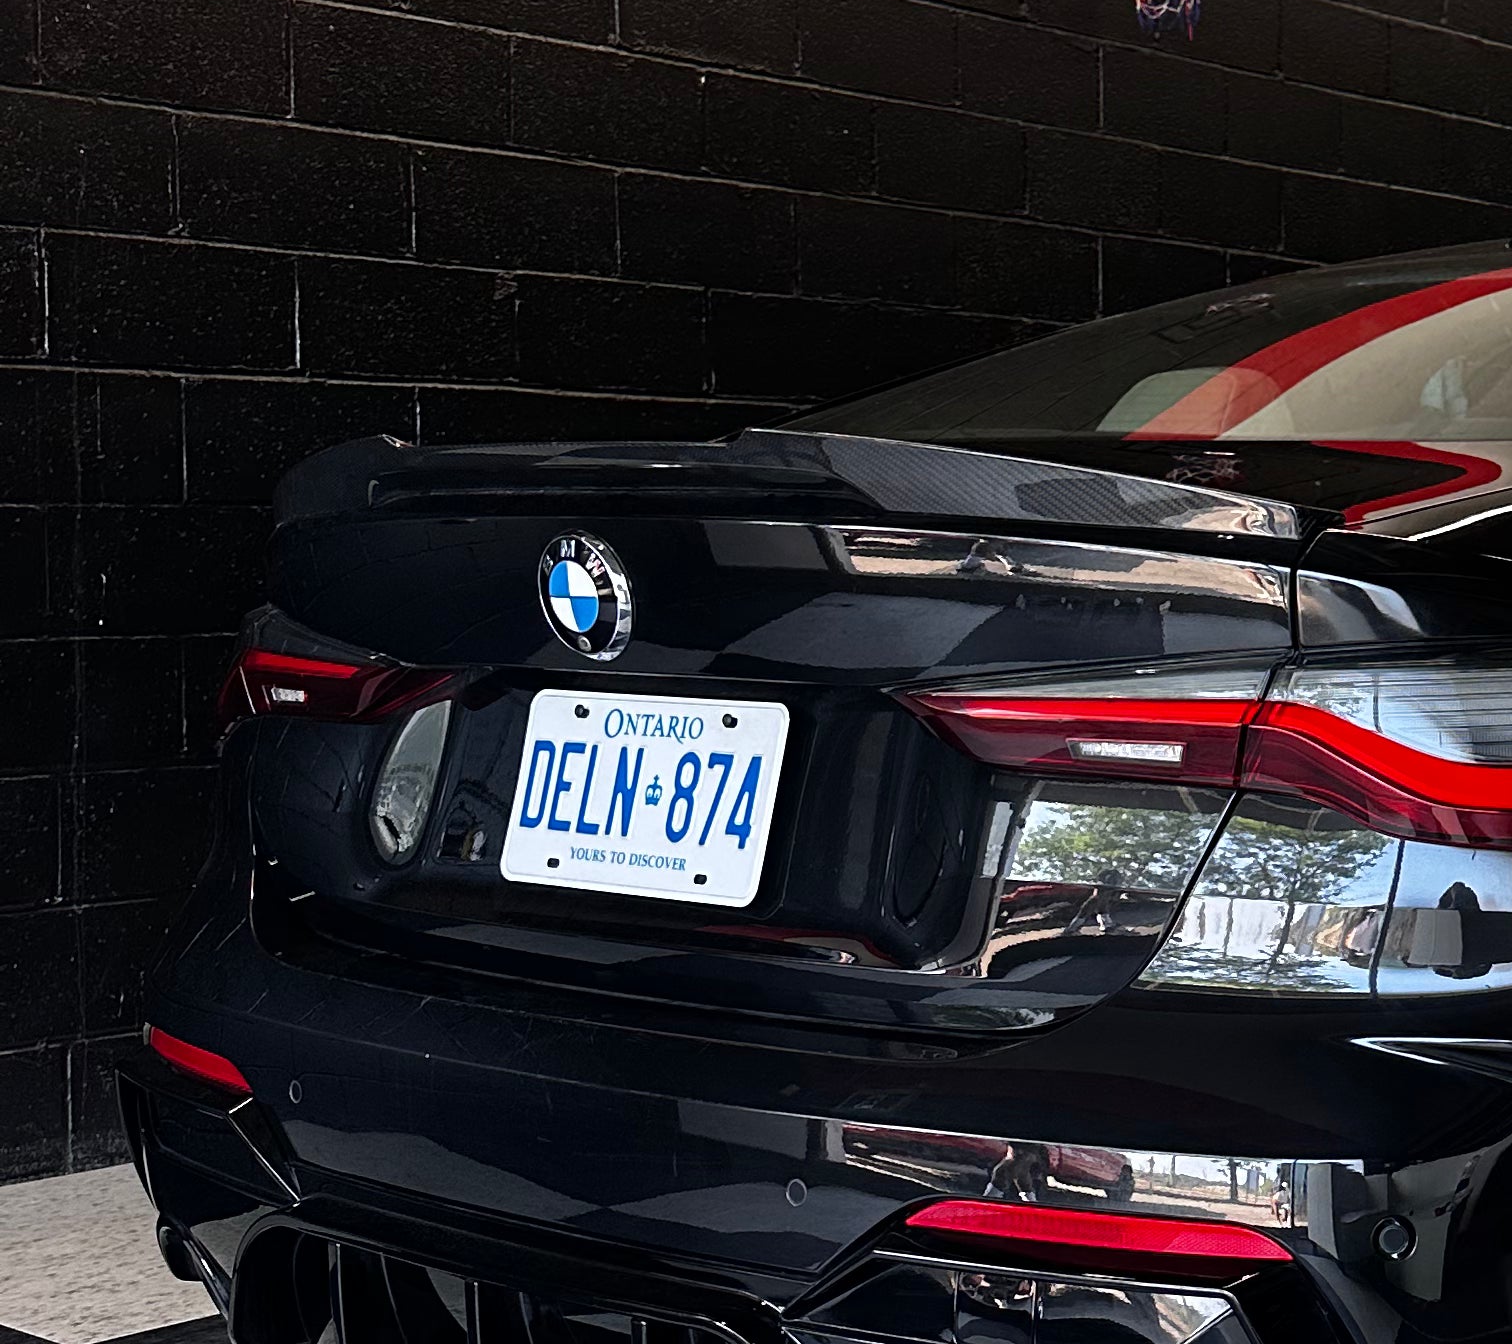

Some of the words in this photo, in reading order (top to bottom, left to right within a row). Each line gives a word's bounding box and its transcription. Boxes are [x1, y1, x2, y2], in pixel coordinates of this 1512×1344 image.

[543, 539, 606, 578] BMW
[604, 708, 704, 744] ONTARIO
[519, 740, 645, 837] DELN
[665, 751, 763, 849] 874
[570, 846, 606, 863] YOURS
[610, 850, 626, 865] TO
[628, 853, 687, 871] DISCOVER
